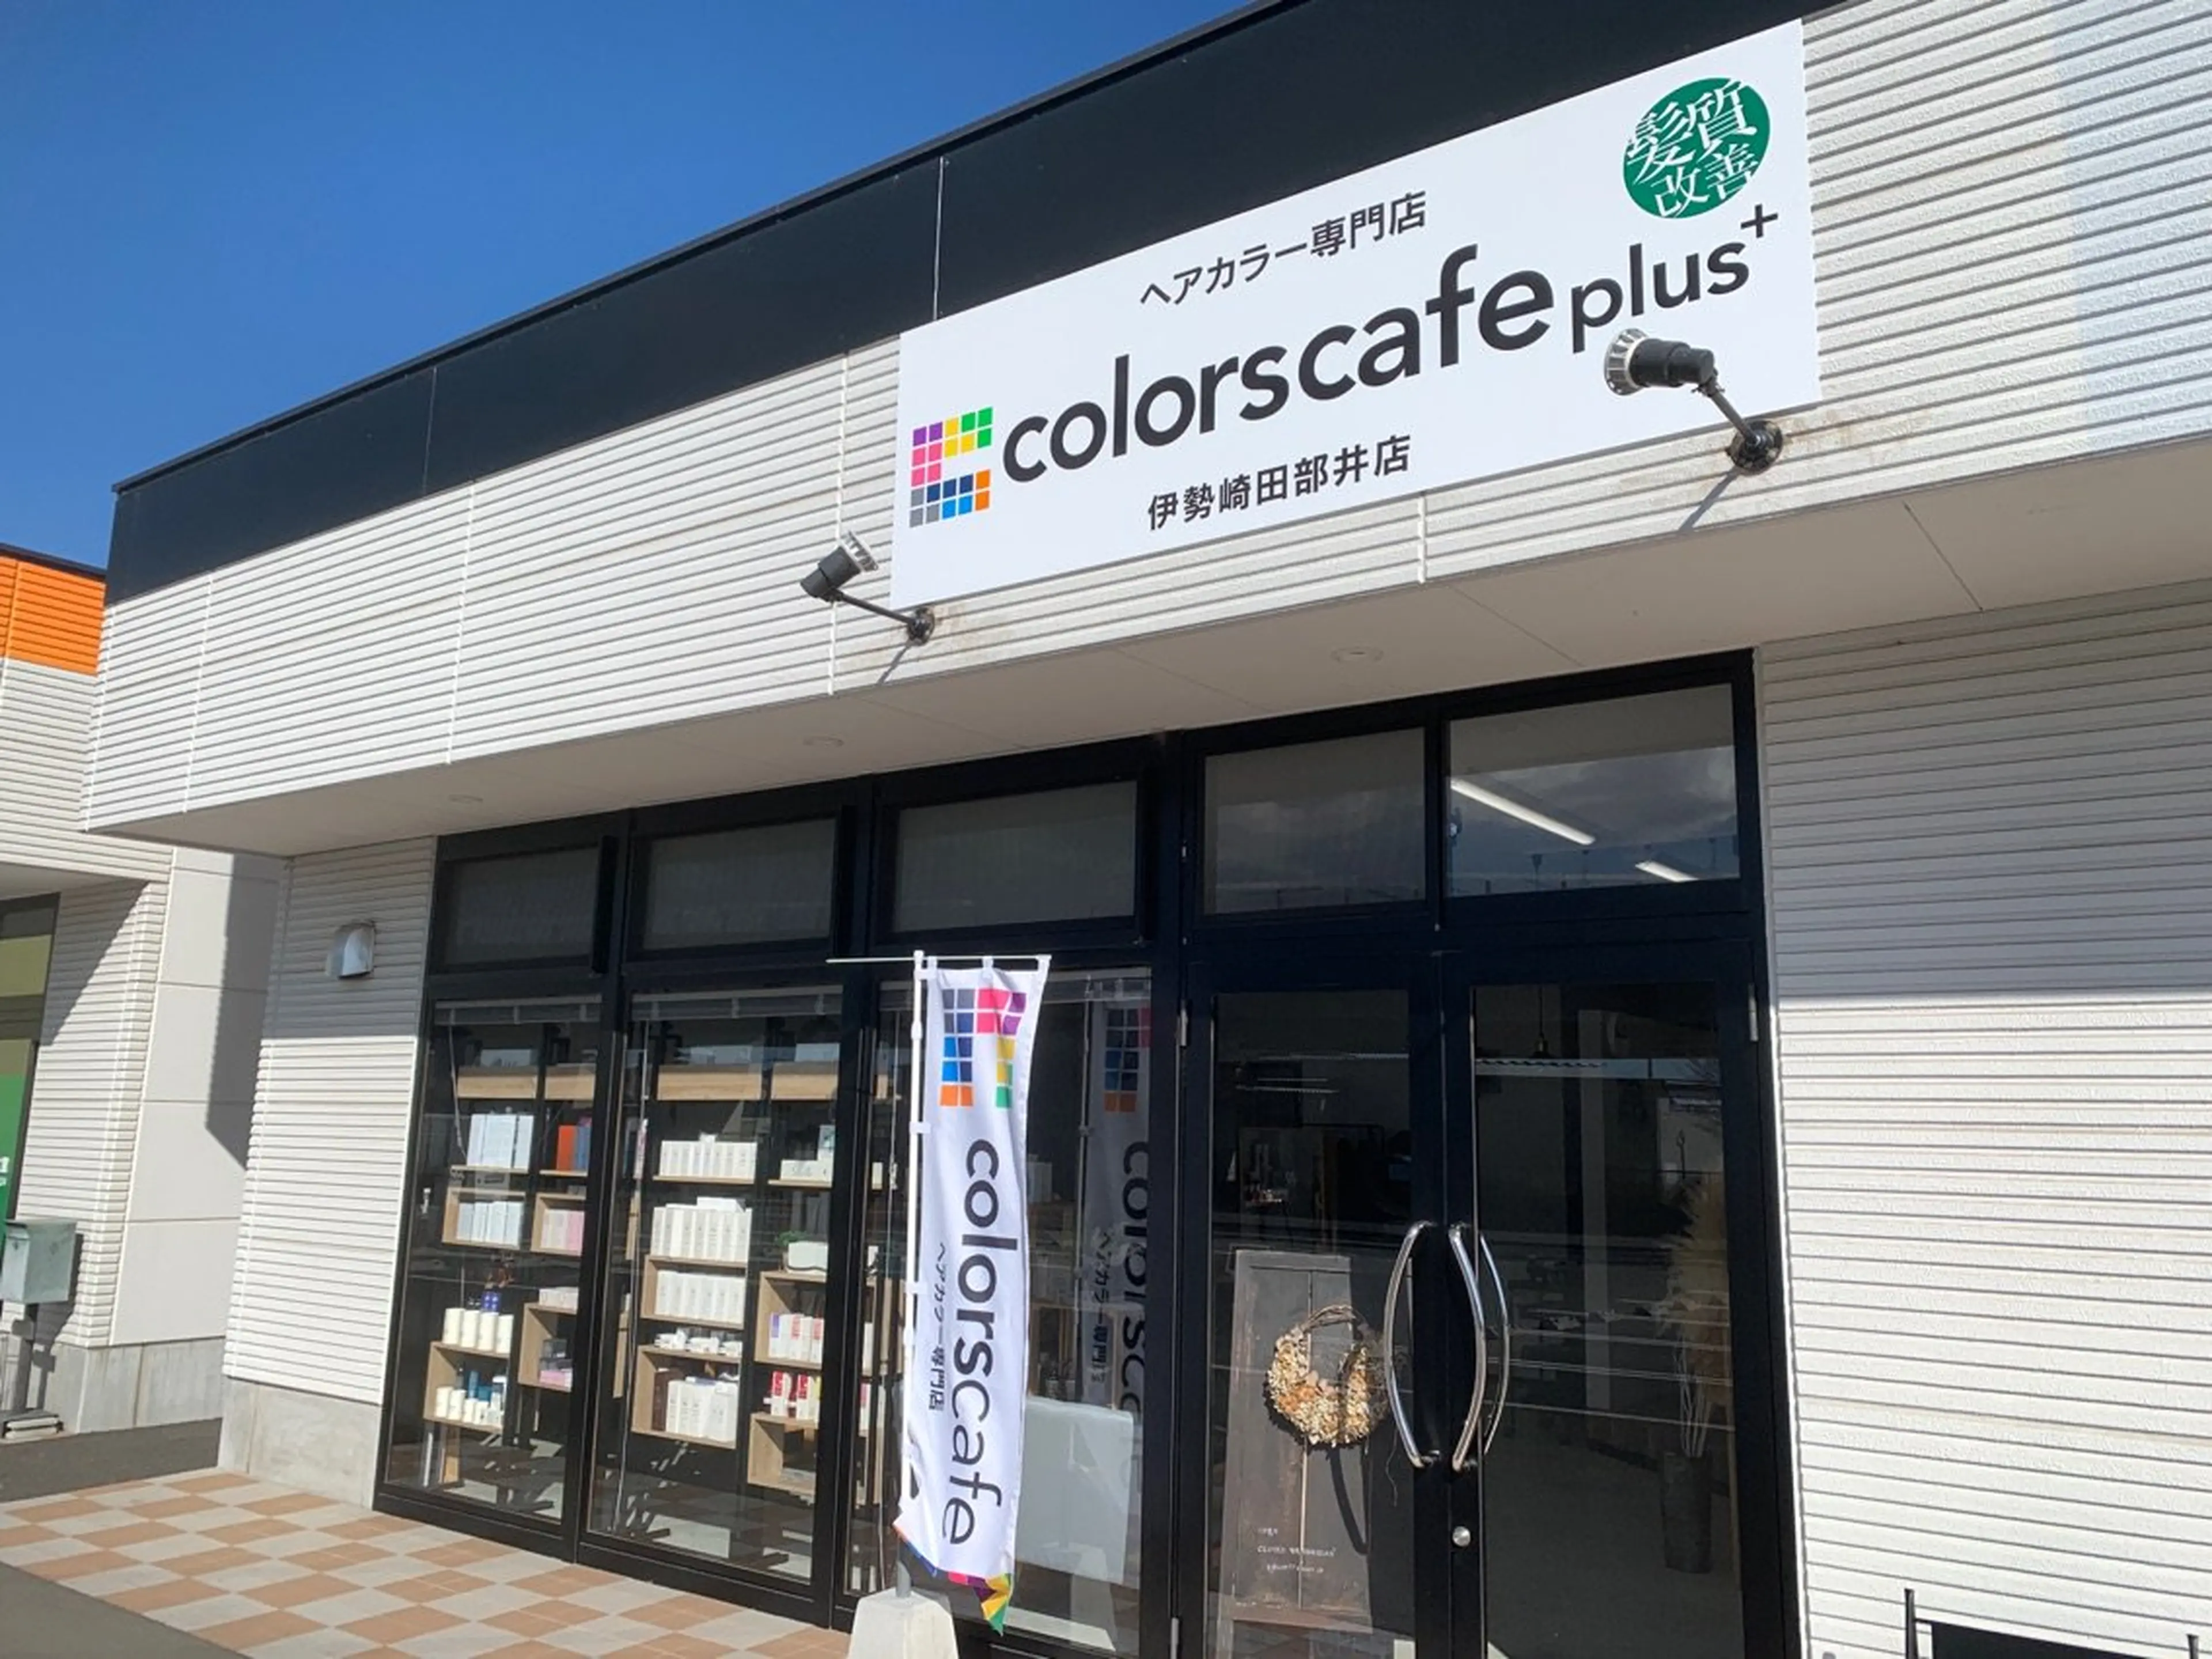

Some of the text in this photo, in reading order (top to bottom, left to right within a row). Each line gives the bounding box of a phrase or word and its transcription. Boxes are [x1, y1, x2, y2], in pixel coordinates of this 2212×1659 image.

[1626, 79, 1758, 185] 髪質
[1650, 143, 1759, 218] 改善
[1139, 191, 1426, 305] ヘアカラー専門店
[1003, 244, 1554, 483] colorscafe
[1147, 434, 1411, 531] 伊勢崎田部井店
[944, 1138, 1018, 1545] colorscafe
